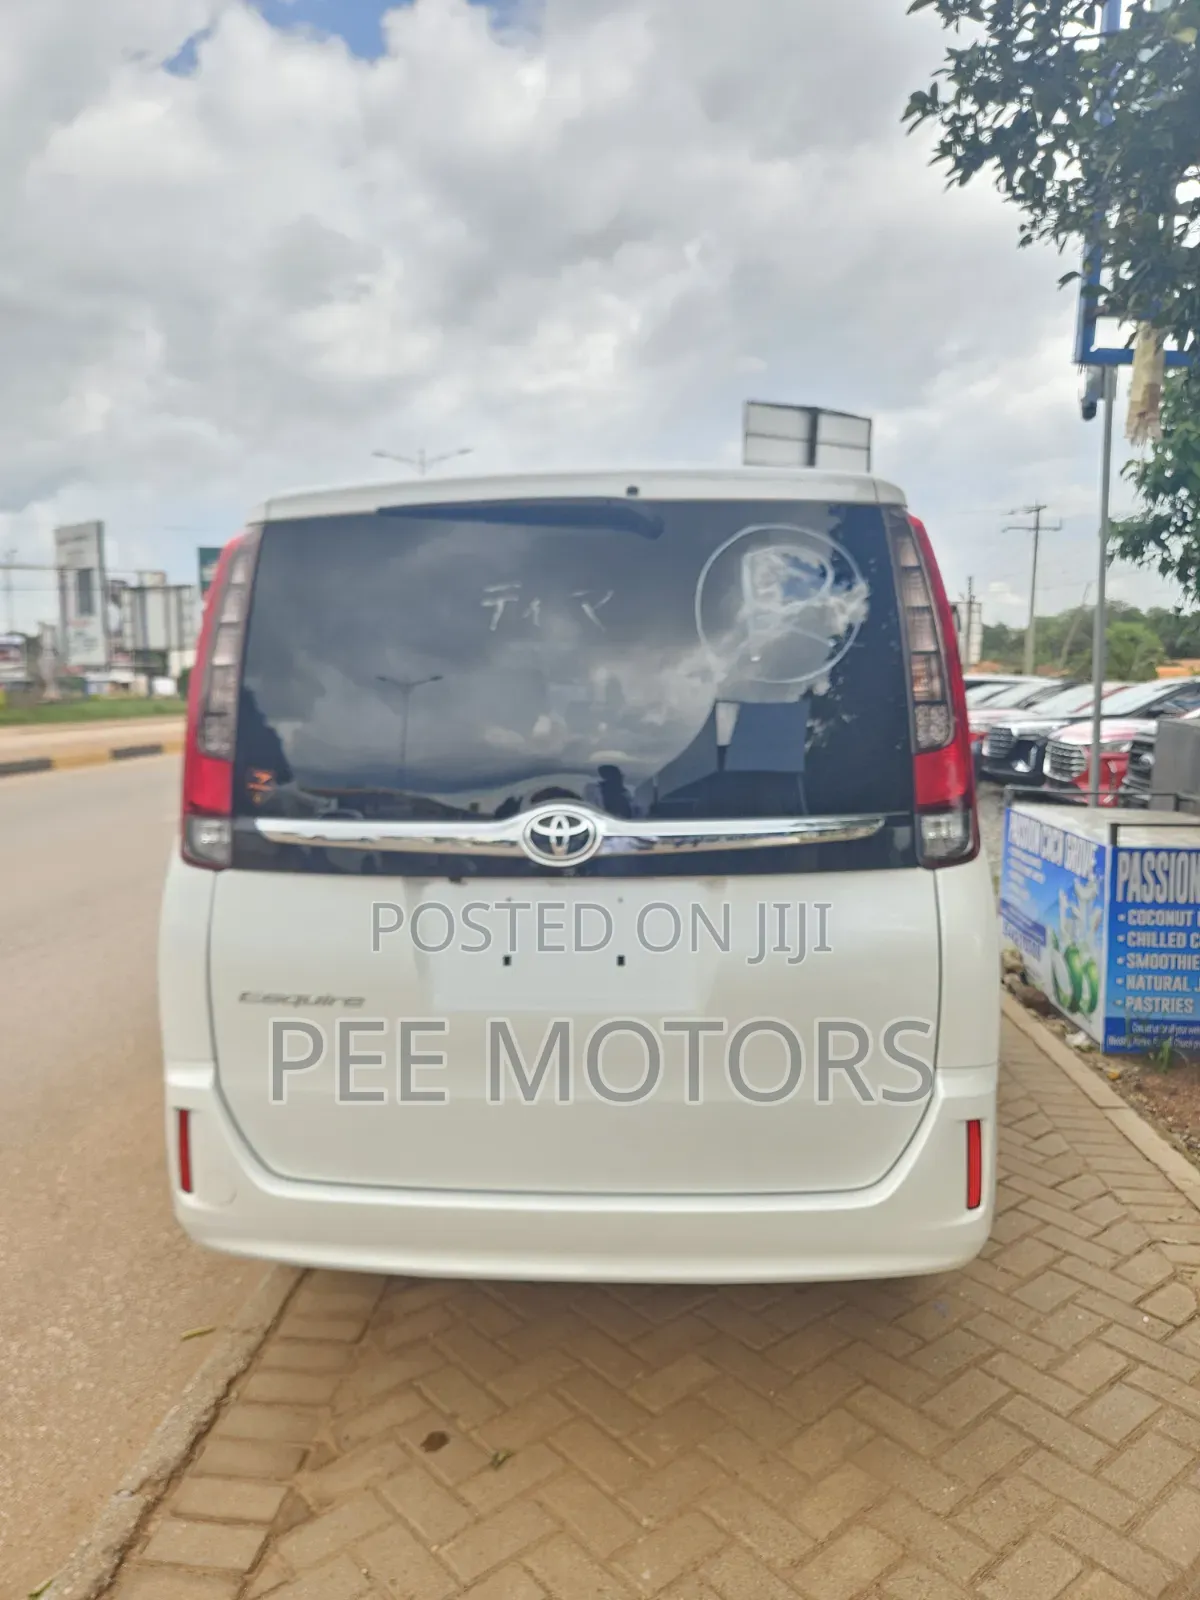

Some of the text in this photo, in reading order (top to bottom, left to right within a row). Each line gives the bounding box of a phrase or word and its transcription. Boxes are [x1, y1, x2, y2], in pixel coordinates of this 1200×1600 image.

[1116, 850, 1200, 904] PASSION
[1127, 909, 1194, 927] COCONUT
[1127, 931, 1187, 949] CHILLED
[1126, 974, 1191, 992] NATURAL
[1125, 995, 1194, 1014] PASTRIES
